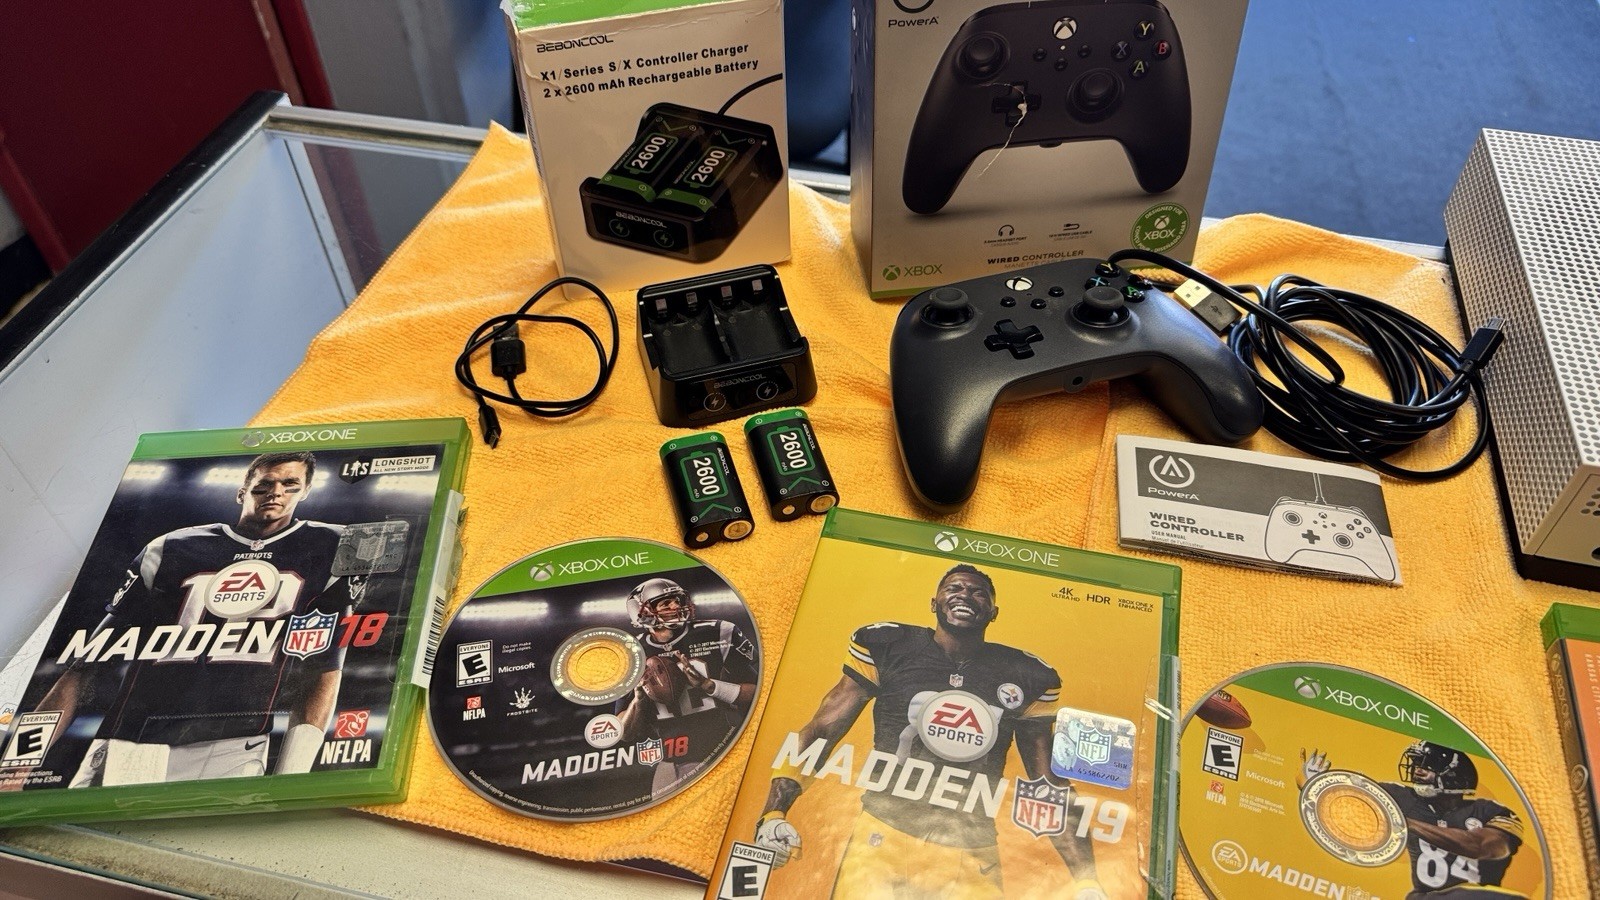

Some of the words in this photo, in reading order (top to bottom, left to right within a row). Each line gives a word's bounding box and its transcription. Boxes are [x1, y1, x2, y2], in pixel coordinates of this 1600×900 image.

[888, 16, 939, 28] PowerA
[1141, 23, 1151, 36] Y
[536, 34, 614, 53] BEBONCOOL
[1116, 43, 1128, 56] X
[1158, 42, 1167, 55] B
[608, 60, 631, 73] S/X
[636, 50, 699, 68] Controller
[702, 44, 749, 60] Charger
[1133, 61, 1145, 74] A
[543, 88, 551, 98] 2
[554, 88, 562, 97] x
[565, 83, 595, 96] 2600
[598, 77, 625, 91] mAh
[629, 66, 712, 86] Rechargeable
[715, 59, 759, 76] Battery
[631, 136, 667, 169] 2600
[691, 150, 726, 183] 2600
[1143, 228, 1176, 241] XBOX
[987, 256, 1020, 265] WIRED
[1021, 250, 1085, 262] CONTROLLER
[904, 264, 943, 277] XBOX
[266, 430, 315, 444] XBOX
[316, 428, 358, 442] ONE
[780, 432, 807, 469] 2600
[375, 457, 431, 467] LONGSHOT
[693, 457, 720, 495] 2600
[1148, 487, 1200, 500] PowerA
[1149, 511, 1196, 525] WIRED
[1150, 520, 1245, 541] CONTROLLER
[1166, 532, 1187, 541] MANUAL
[233, 552, 274, 560] PATRIOTS
[962, 538, 1018, 560] XBOX
[1018, 548, 1061, 567] ONE
[559, 557, 610, 576] XBOX
[610, 552, 651, 569] ONE
[217, 572, 267, 592] EA
[213, 592, 266, 603] SPORTS
[1059, 587, 1074, 596] 4K
[1086, 594, 1111, 605] HDR
[1118, 598, 1135, 606] XBOX
[1119, 603, 1153, 613] ENHANCED
[56, 619, 285, 664] MADDEN
[288, 628, 327, 652] NFL
[337, 612, 389, 649] 18
[459, 643, 489, 653] EVERYONE
[462, 653, 488, 677] E
[498, 662, 536, 674] Microsoft
[463, 708, 486, 721] NFLPA
[1324, 686, 1384, 716] XBOX
[1384, 704, 1431, 729] ONE
[22, 714, 58, 723] EVERYONE
[930, 702, 984, 734] EA
[591, 720, 618, 735] EA
[16, 727, 43, 757] E
[590, 731, 619, 741] SPORTS
[927, 725, 984, 746] SPORTS
[1210, 731, 1241, 745] EVERYONE
[320, 738, 371, 765] NFLPA
[1081, 742, 1105, 759] NFL
[1210, 744, 1235, 768] E
[2, 759, 41, 767] ESRB
[521, 745, 634, 785] MADDEN
[640, 749, 660, 762] NFL
[664, 736, 689, 758] 18
[43, 775, 62, 783] ESRB
[1203, 765, 1237, 780] ESRB
[1245, 771, 1285, 789] Microsoft
[771, 732, 1010, 819] MADDEN
[1017, 799, 1061, 832] NFL
[1073, 796, 1130, 844] 19
[1206, 790, 1227, 806] NFLPA
[734, 846, 772, 861] EVERYONE
[1219, 846, 1241, 862] EA
[1217, 855, 1242, 868] SPORTS
[732, 865, 759, 897] E
[1249, 857, 1345, 900] MADDEN
